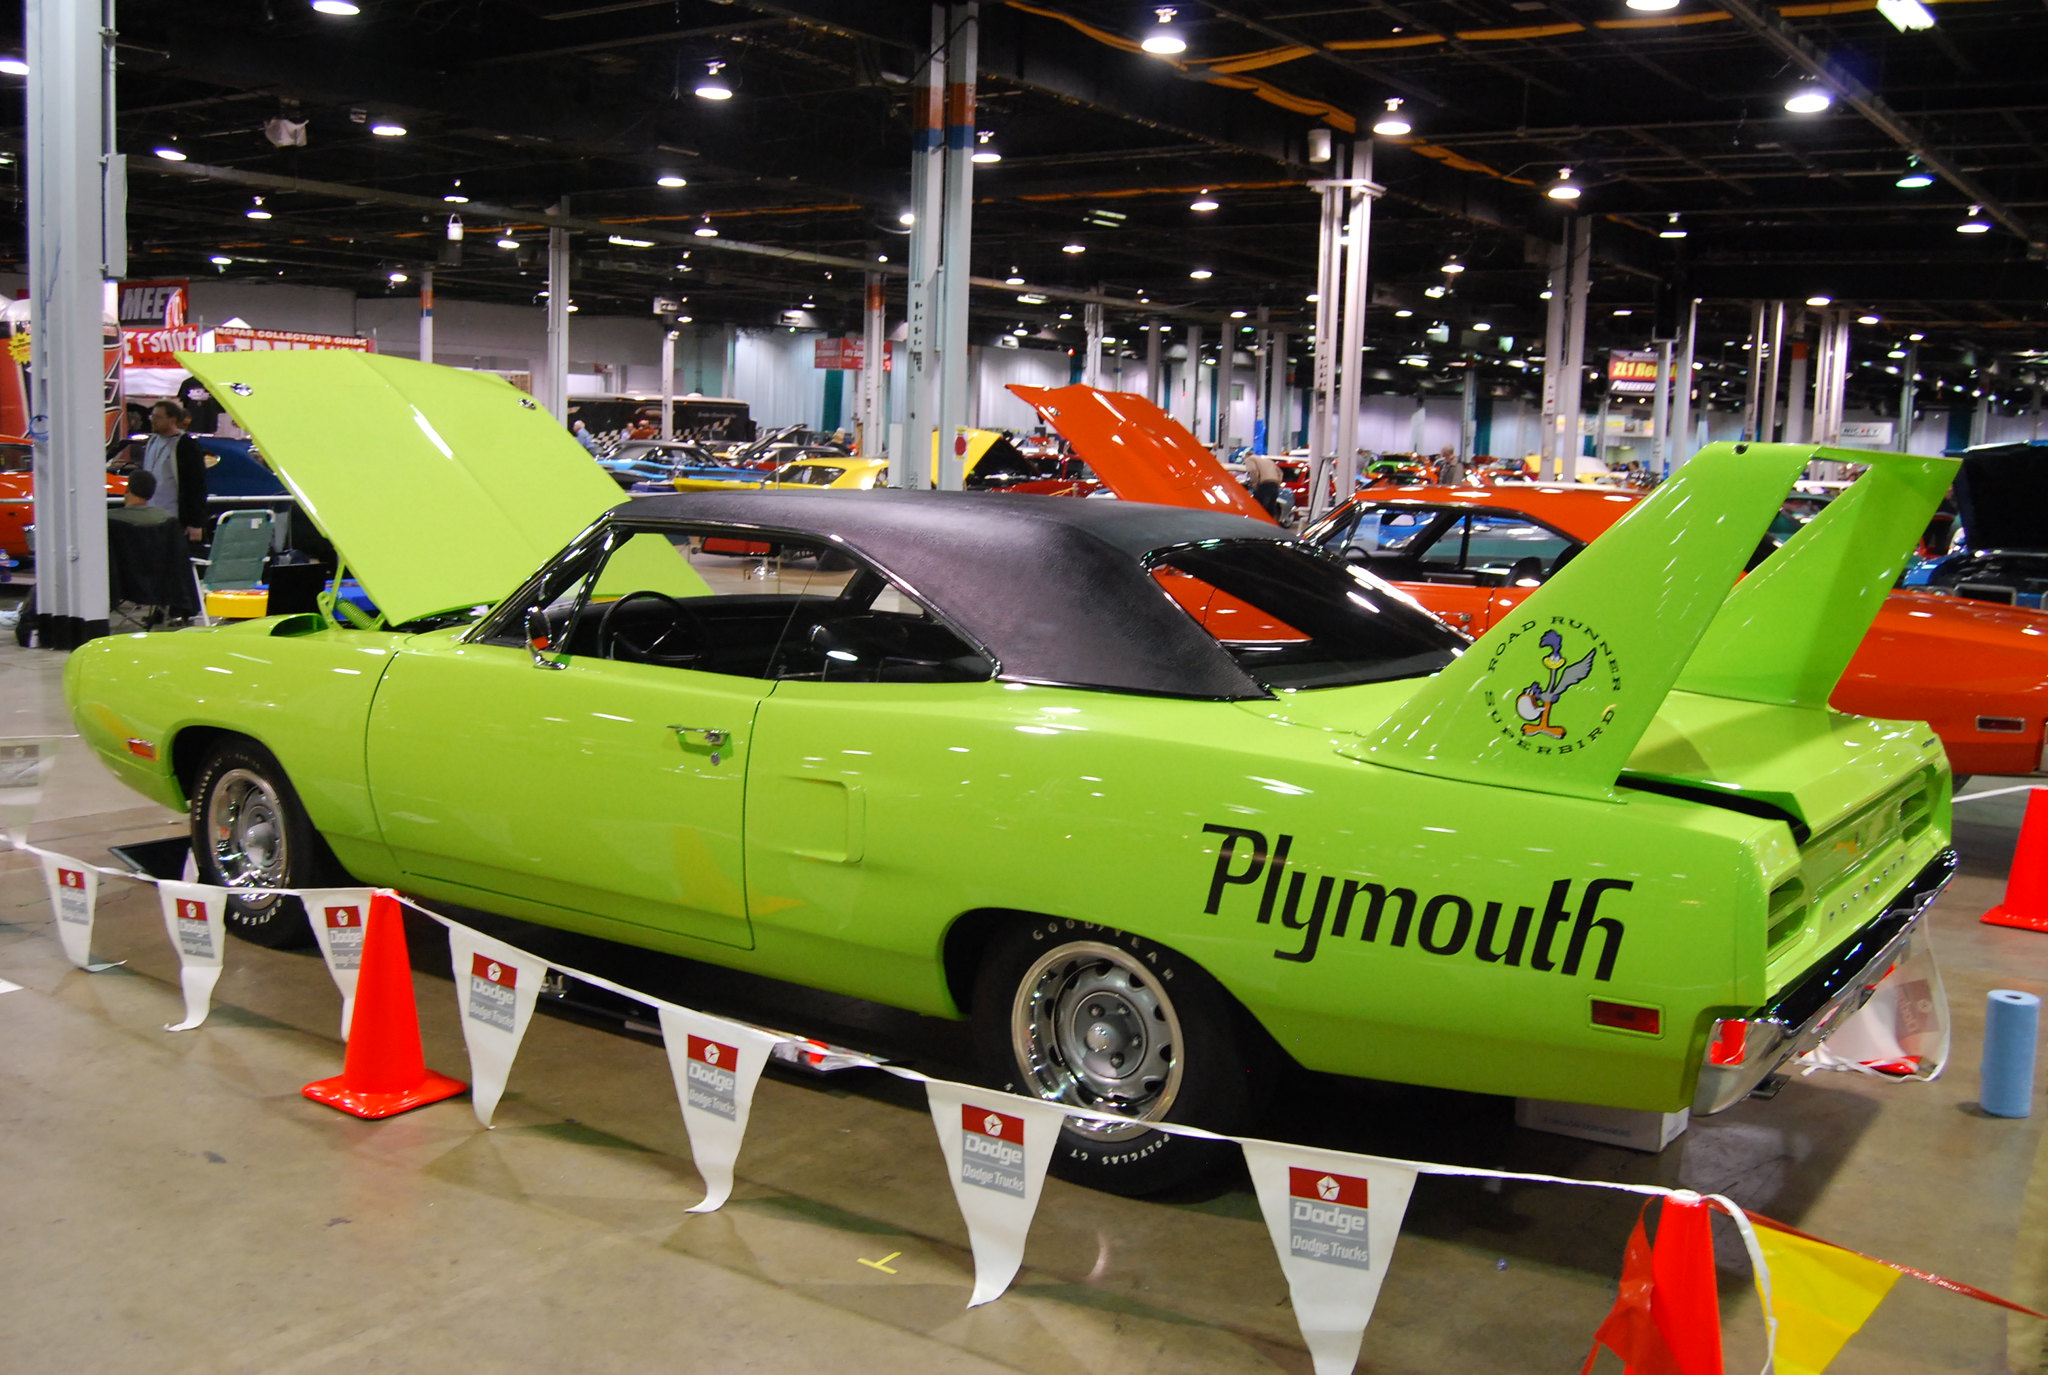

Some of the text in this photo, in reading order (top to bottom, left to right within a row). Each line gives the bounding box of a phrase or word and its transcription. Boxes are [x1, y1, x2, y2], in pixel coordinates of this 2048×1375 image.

[1488, 616, 1621, 691] ROAD RUNNER
[1485, 691, 1614, 755] SUPERBIRD
[1202, 823, 1634, 982] Plymouth
[472, 978, 514, 1005] Dodge
[689, 1063, 734, 1091] Dodge
[689, 1089, 736, 1116] Dodge Trucks
[965, 1135, 1022, 1166] Dodge
[1070, 1132, 1171, 1165] POLYGLAS GT
[963, 1164, 1025, 1192] Dodge Trucks
[1294, 1201, 1366, 1234] Dodge
[1292, 1235, 1369, 1262] Dodge Trucks
